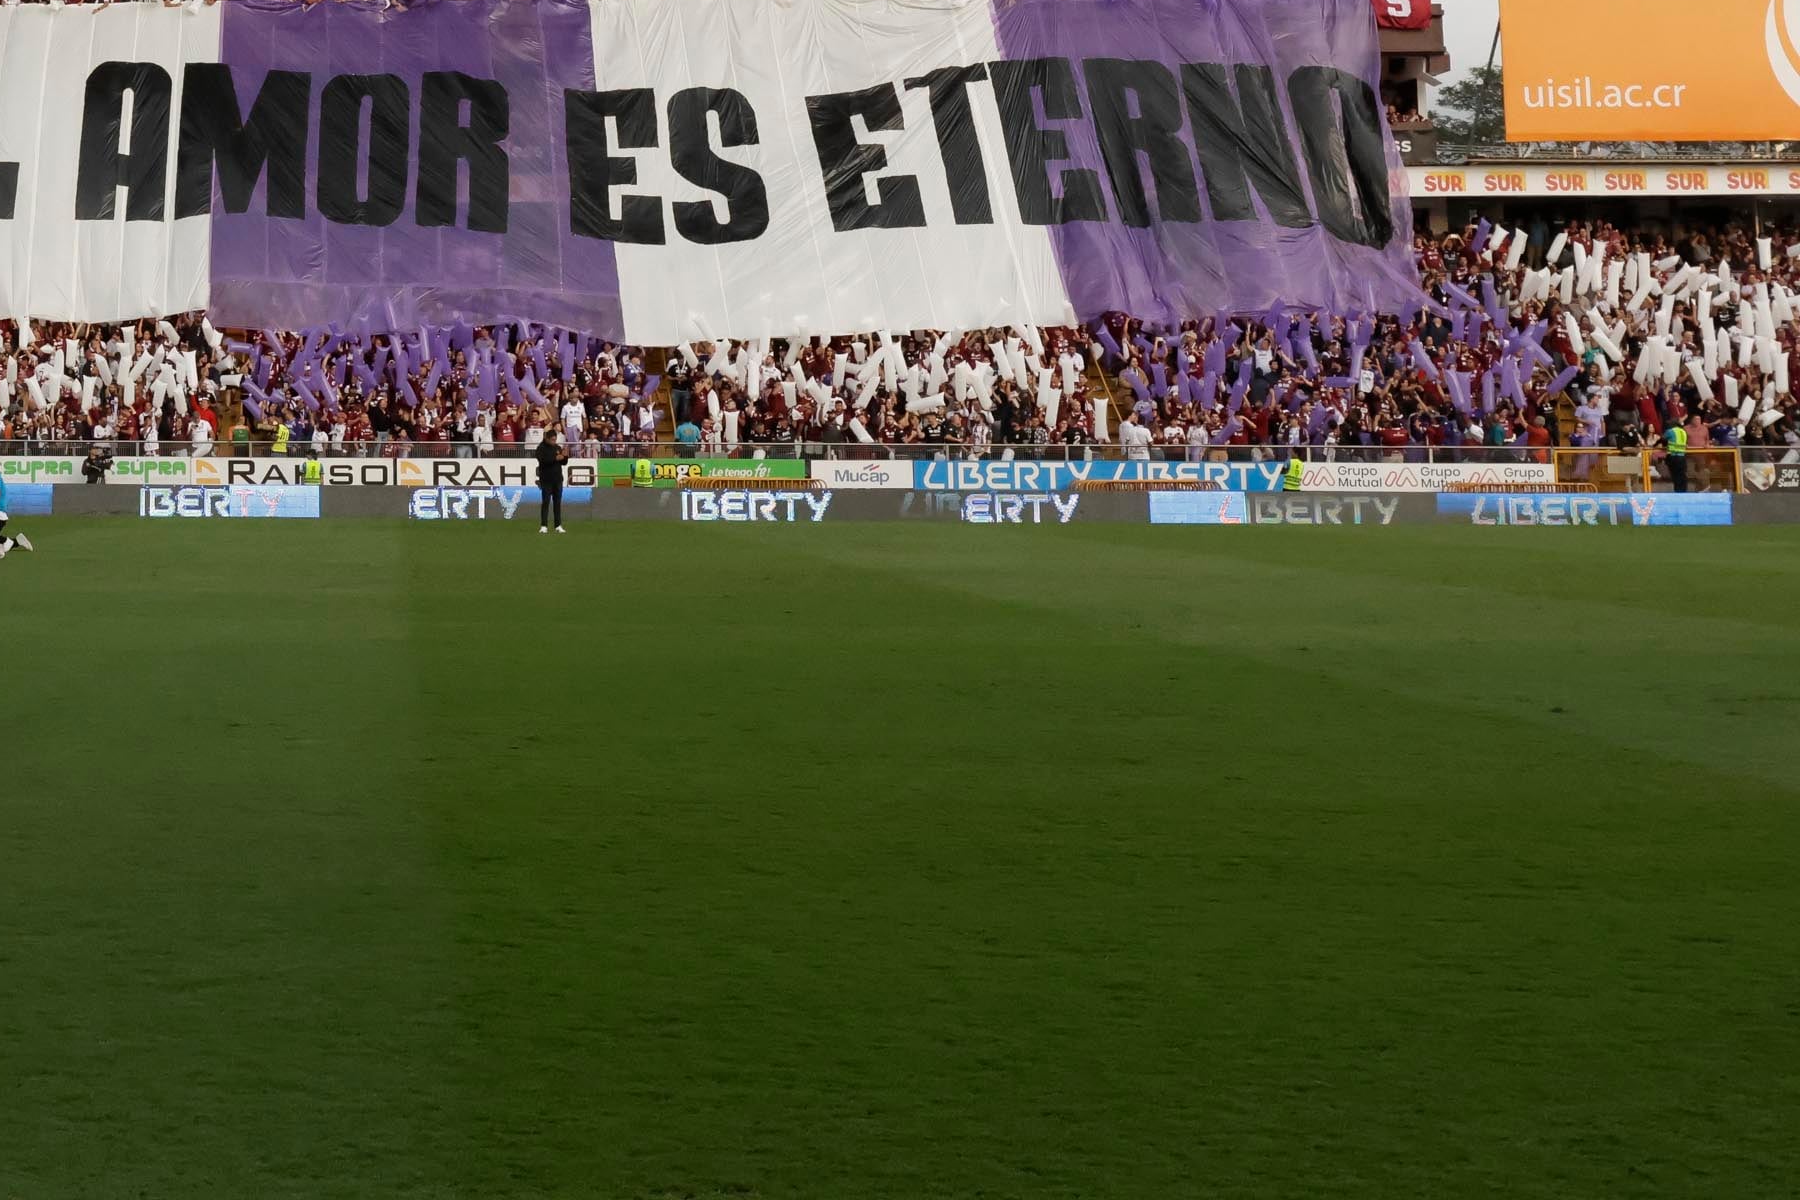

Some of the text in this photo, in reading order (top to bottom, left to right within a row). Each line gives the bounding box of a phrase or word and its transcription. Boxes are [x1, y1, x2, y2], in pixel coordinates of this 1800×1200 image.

[1523, 75, 1687, 108] uisil.ac.cr
[75, 60, 510, 234] AMOR
[564, 86, 770, 245] ES
[805, 56, 1393, 250] ETERNO
[1424, 175, 1464, 192] SUR
[1484, 175, 1524, 192] SUR
[1545, 174, 1585, 191] SUR
[1604, 173, 1645, 191] SUR
[1666, 173, 1706, 190] SUR
[1727, 172, 1766, 189] SUR
[3, 461, 73, 483] SUPRA
[116, 461, 186, 483] SUPRA
[834, 469, 890, 486] Mucap
[923, 462, 1093, 490] LIBERTY
[1112, 462, 1283, 491] LIBERTY
[1337, 465, 1378, 479] Grupo
[1420, 466, 1461, 479] Grupo
[1504, 467, 1545, 480] Grupo
[1781, 468, 1799, 479] 50%
[1338, 477, 1383, 488] Mutual
[1777, 478, 1799, 488] Sushi
[1471, 496, 1656, 526] LIBERTY
